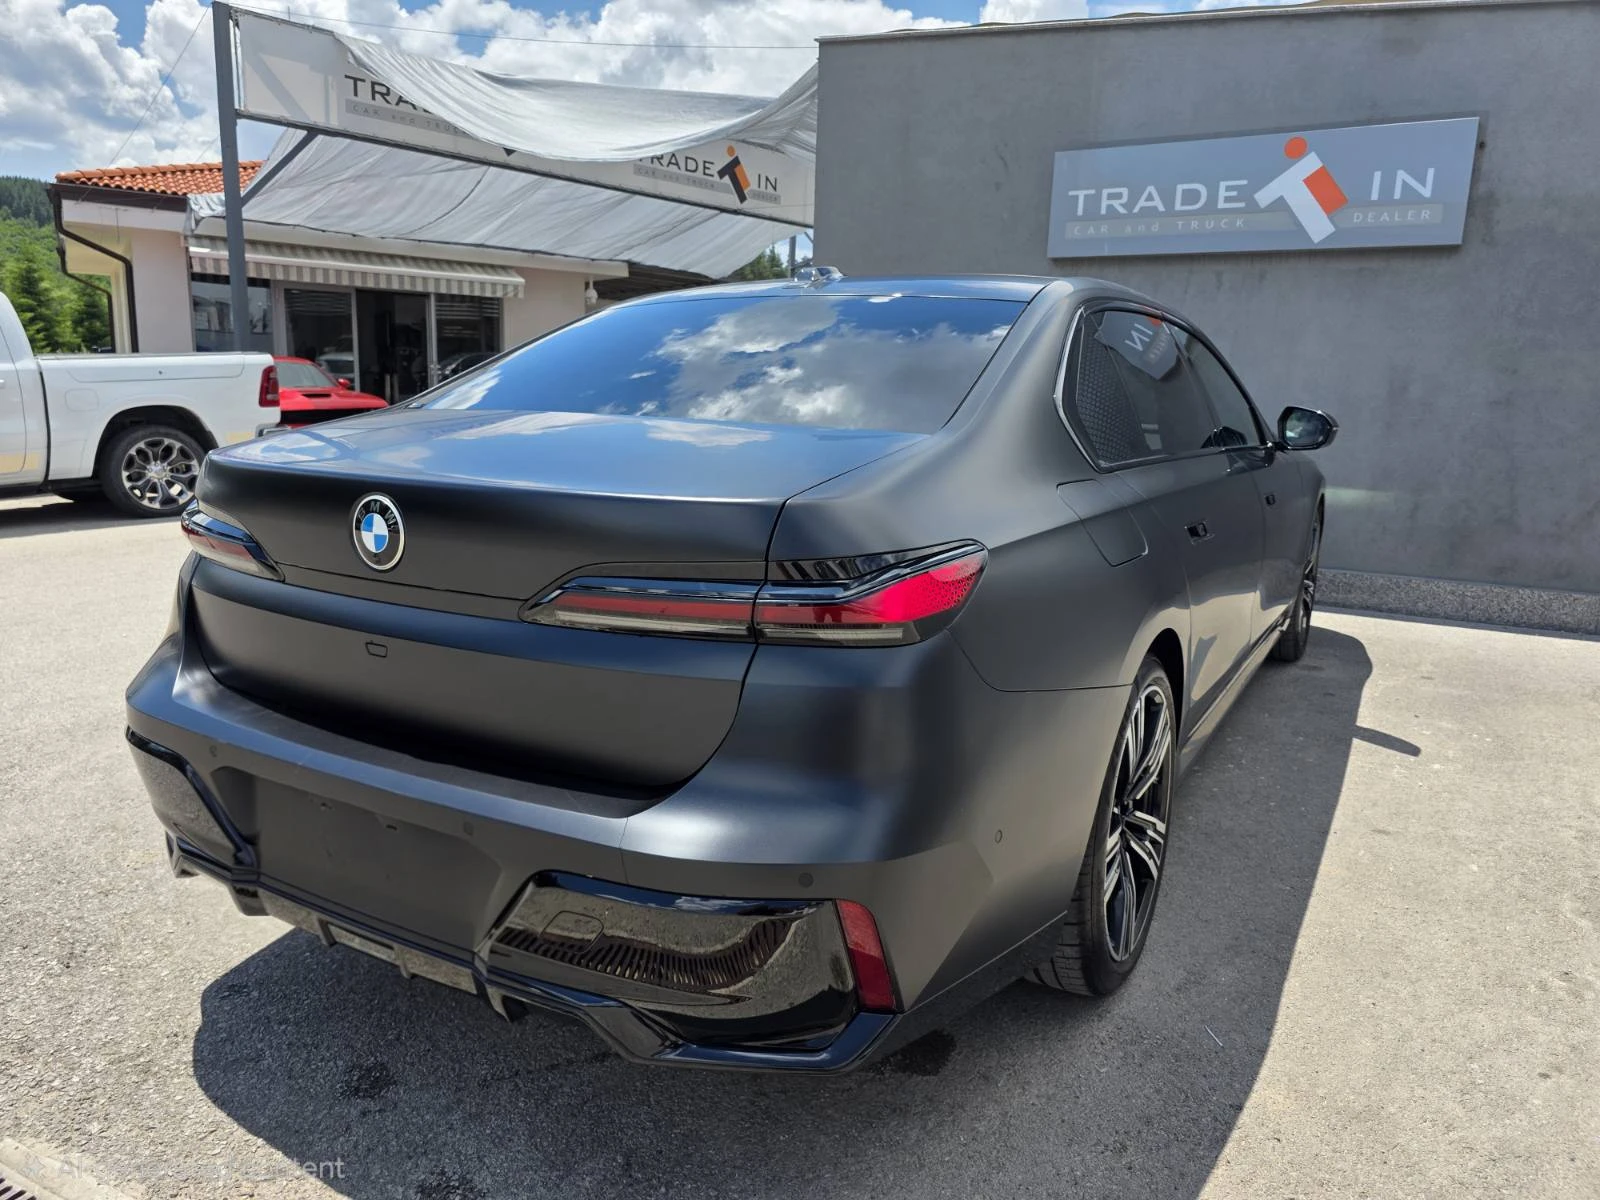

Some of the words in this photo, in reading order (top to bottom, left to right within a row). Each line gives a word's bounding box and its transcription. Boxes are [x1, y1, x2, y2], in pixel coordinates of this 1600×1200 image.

[344, 74, 432, 115] TRA
[639, 152, 715, 178] RADE
[757, 173, 778, 192] IN
[1068, 180, 1249, 217] TRADE
[1370, 167, 1435, 201] IN
[1074, 224, 1109, 236] CAR
[1124, 221, 1160, 234] and
[1176, 217, 1246, 231] TRUCK
[1353, 209, 1432, 224] DEALER
[357, 500, 397, 526] BMW
